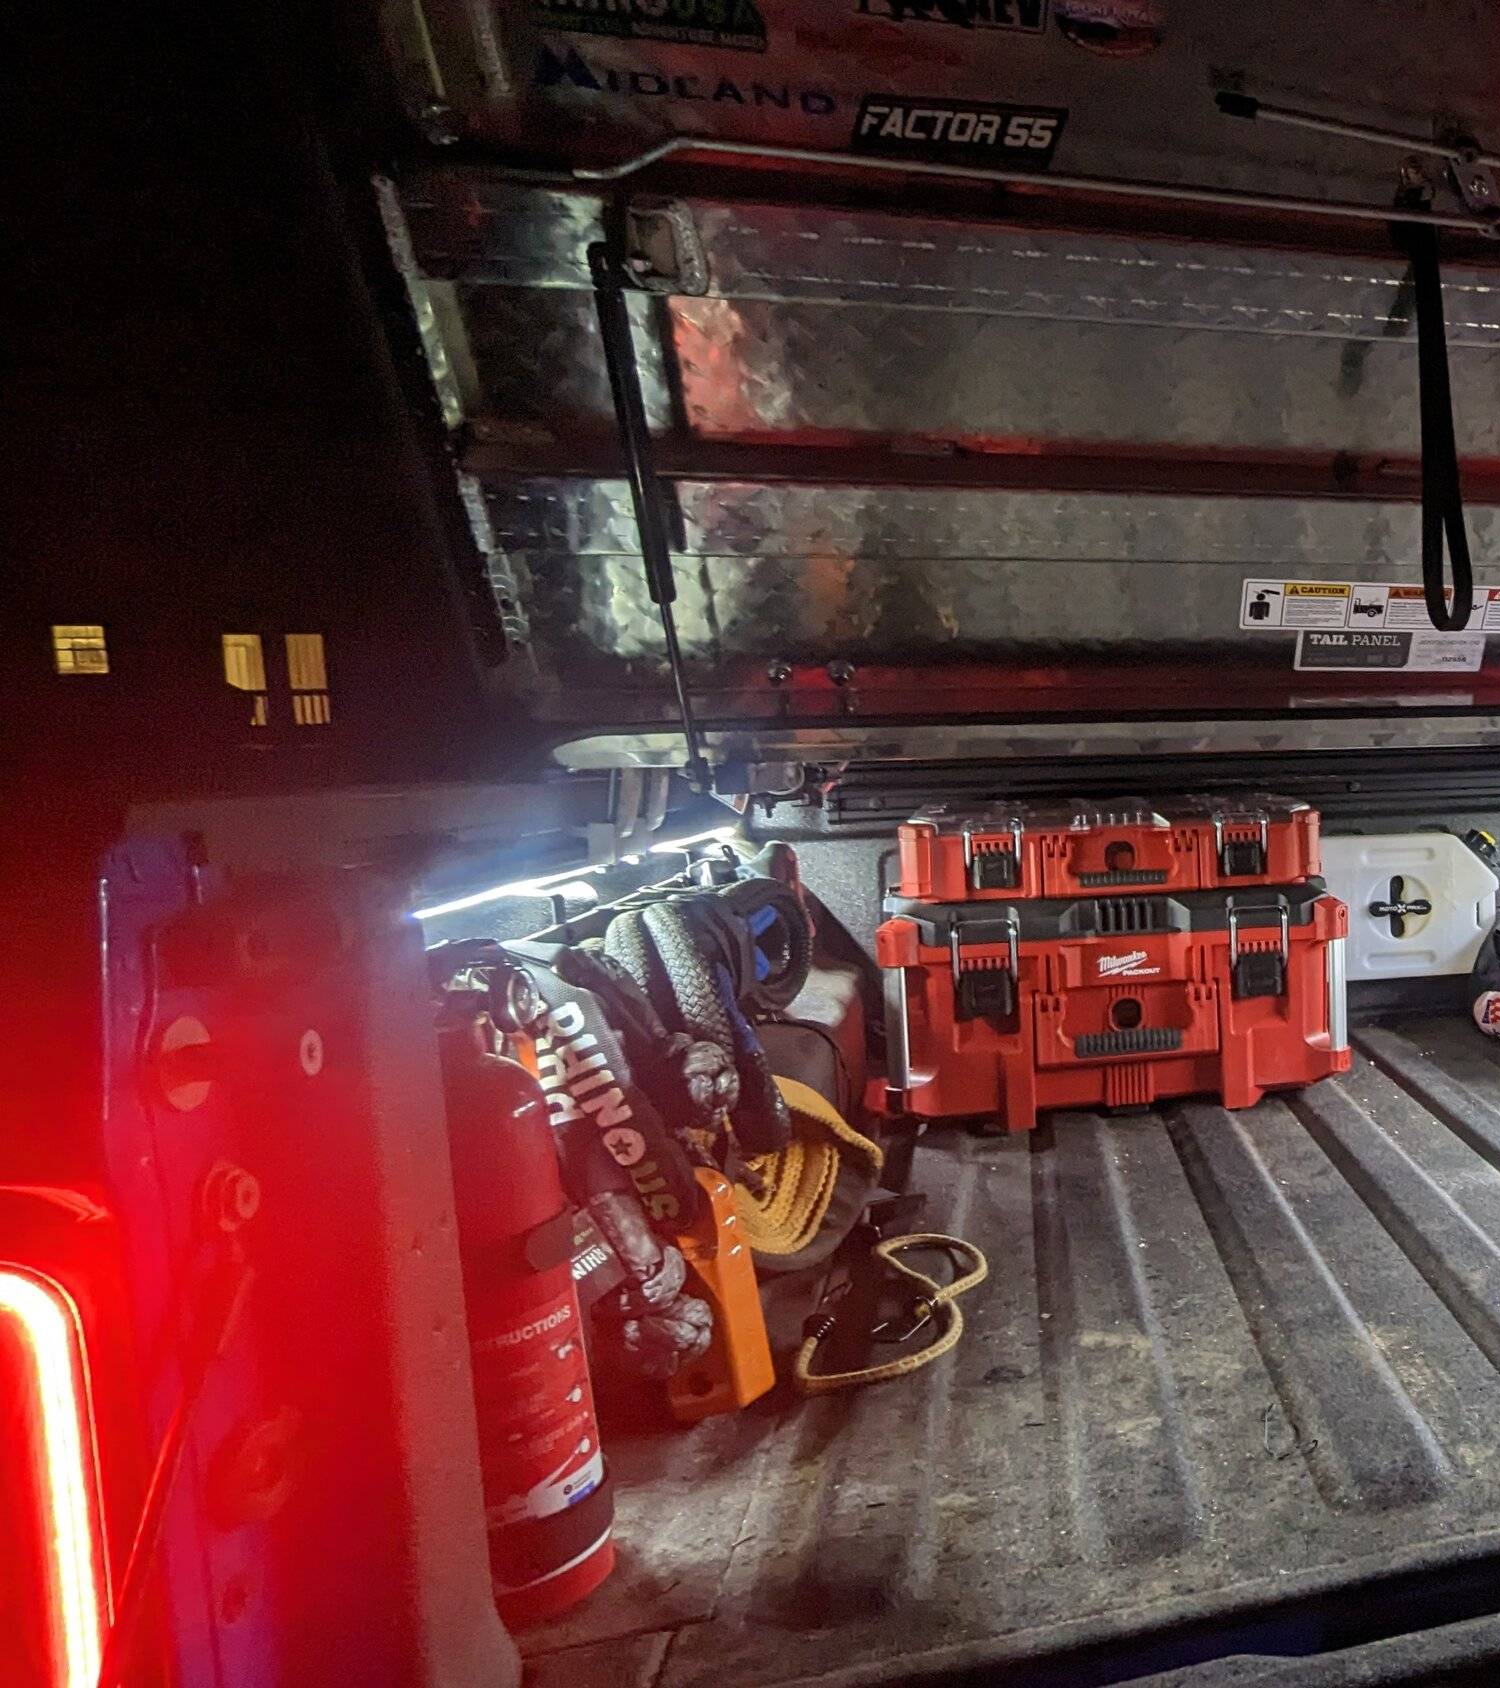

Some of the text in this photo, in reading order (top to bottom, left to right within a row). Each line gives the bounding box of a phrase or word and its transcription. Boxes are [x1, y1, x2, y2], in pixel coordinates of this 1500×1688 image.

[859, 105, 1058, 149] FACTOR 55
[1301, 586, 1346, 595] CAUTION
[1309, 633, 1401, 647] TAIL PANEL
[1122, 967, 1161, 977] PACKOUT
